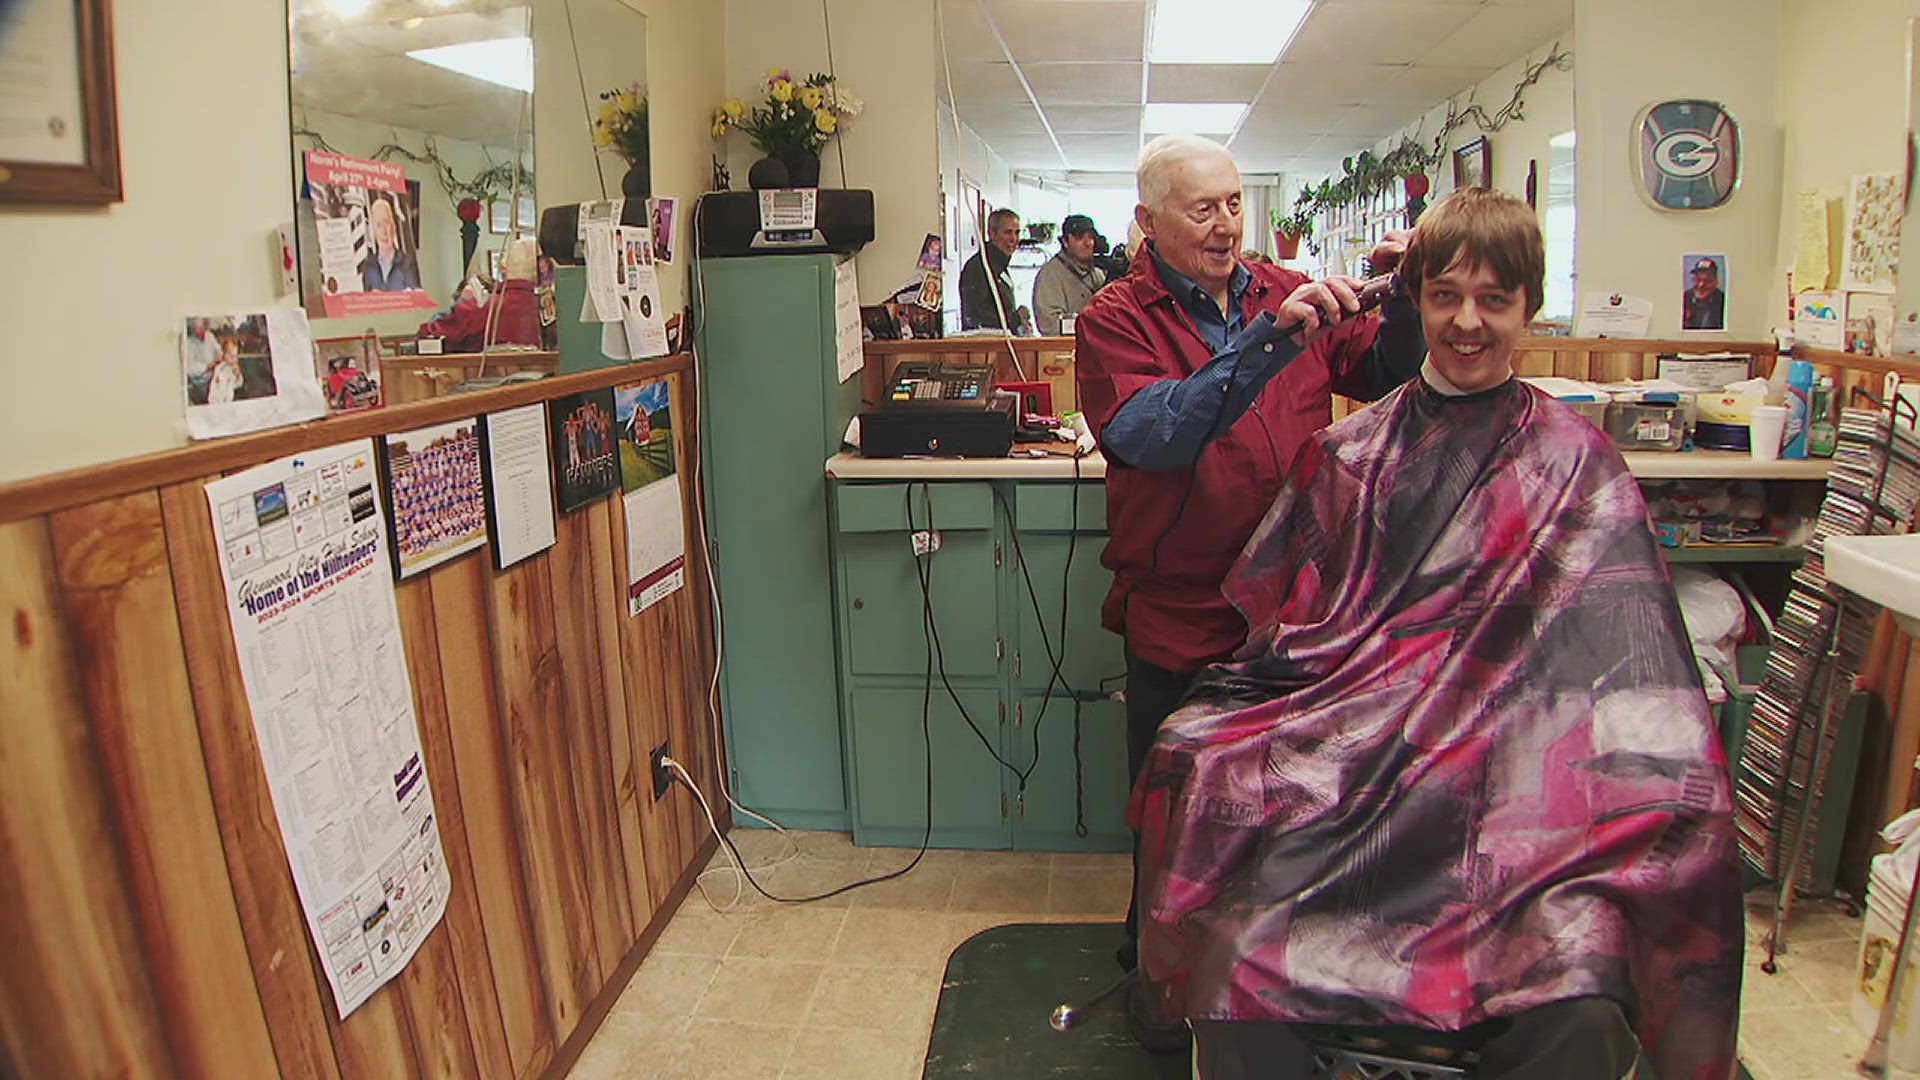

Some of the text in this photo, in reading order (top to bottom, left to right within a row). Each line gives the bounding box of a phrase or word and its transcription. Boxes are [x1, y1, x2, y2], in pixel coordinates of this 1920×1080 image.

[1655, 132, 1718, 178] G
[243, 585, 285, 617] Home
[286, 576, 300, 597] of
[299, 566, 321, 589] the
[321, 539, 378, 579] Hilltoppers
